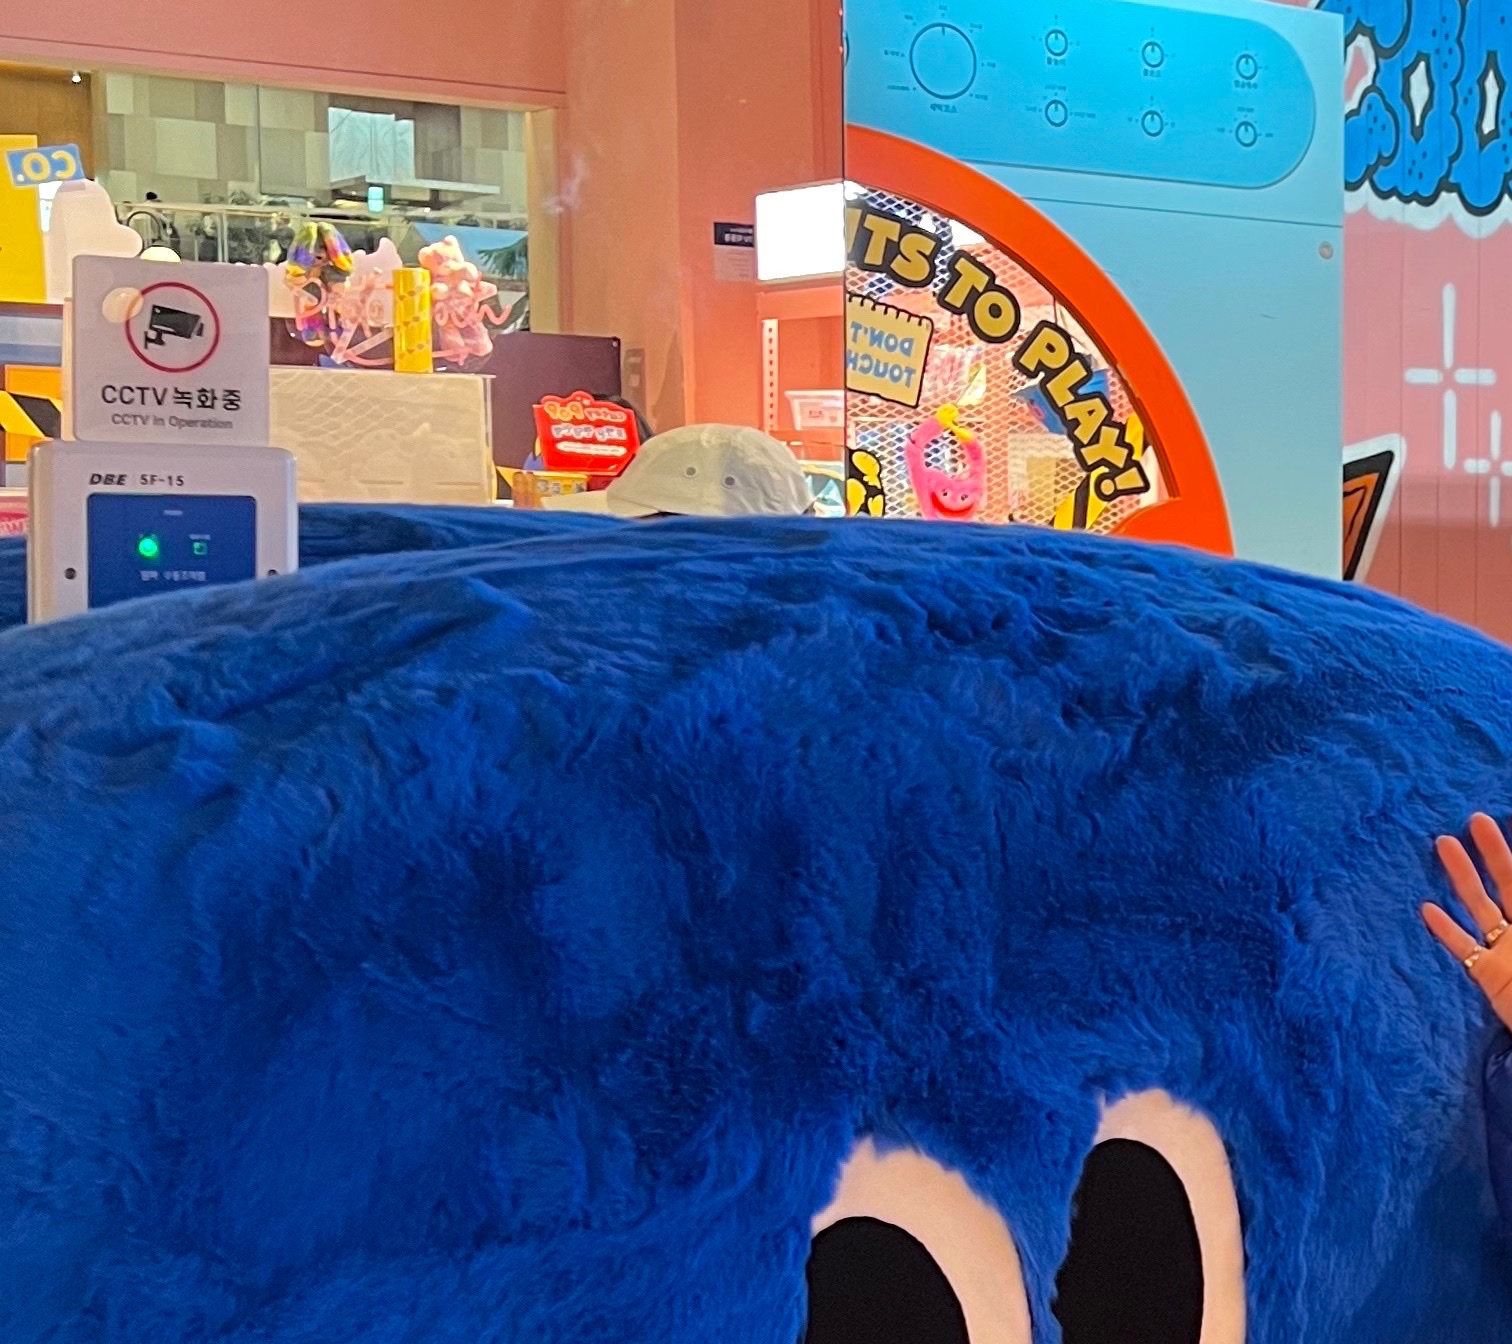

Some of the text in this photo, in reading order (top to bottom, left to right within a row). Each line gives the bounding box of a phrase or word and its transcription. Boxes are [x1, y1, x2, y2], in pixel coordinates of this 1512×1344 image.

[941, 254, 1018, 340] TO
[1015, 323, 1148, 498] PLAY!
[101, 384, 168, 407] CCTV
[111, 413, 150, 426] CCTV
[168, 415, 234, 430] Operation
[88, 473, 128, 486] DBE
